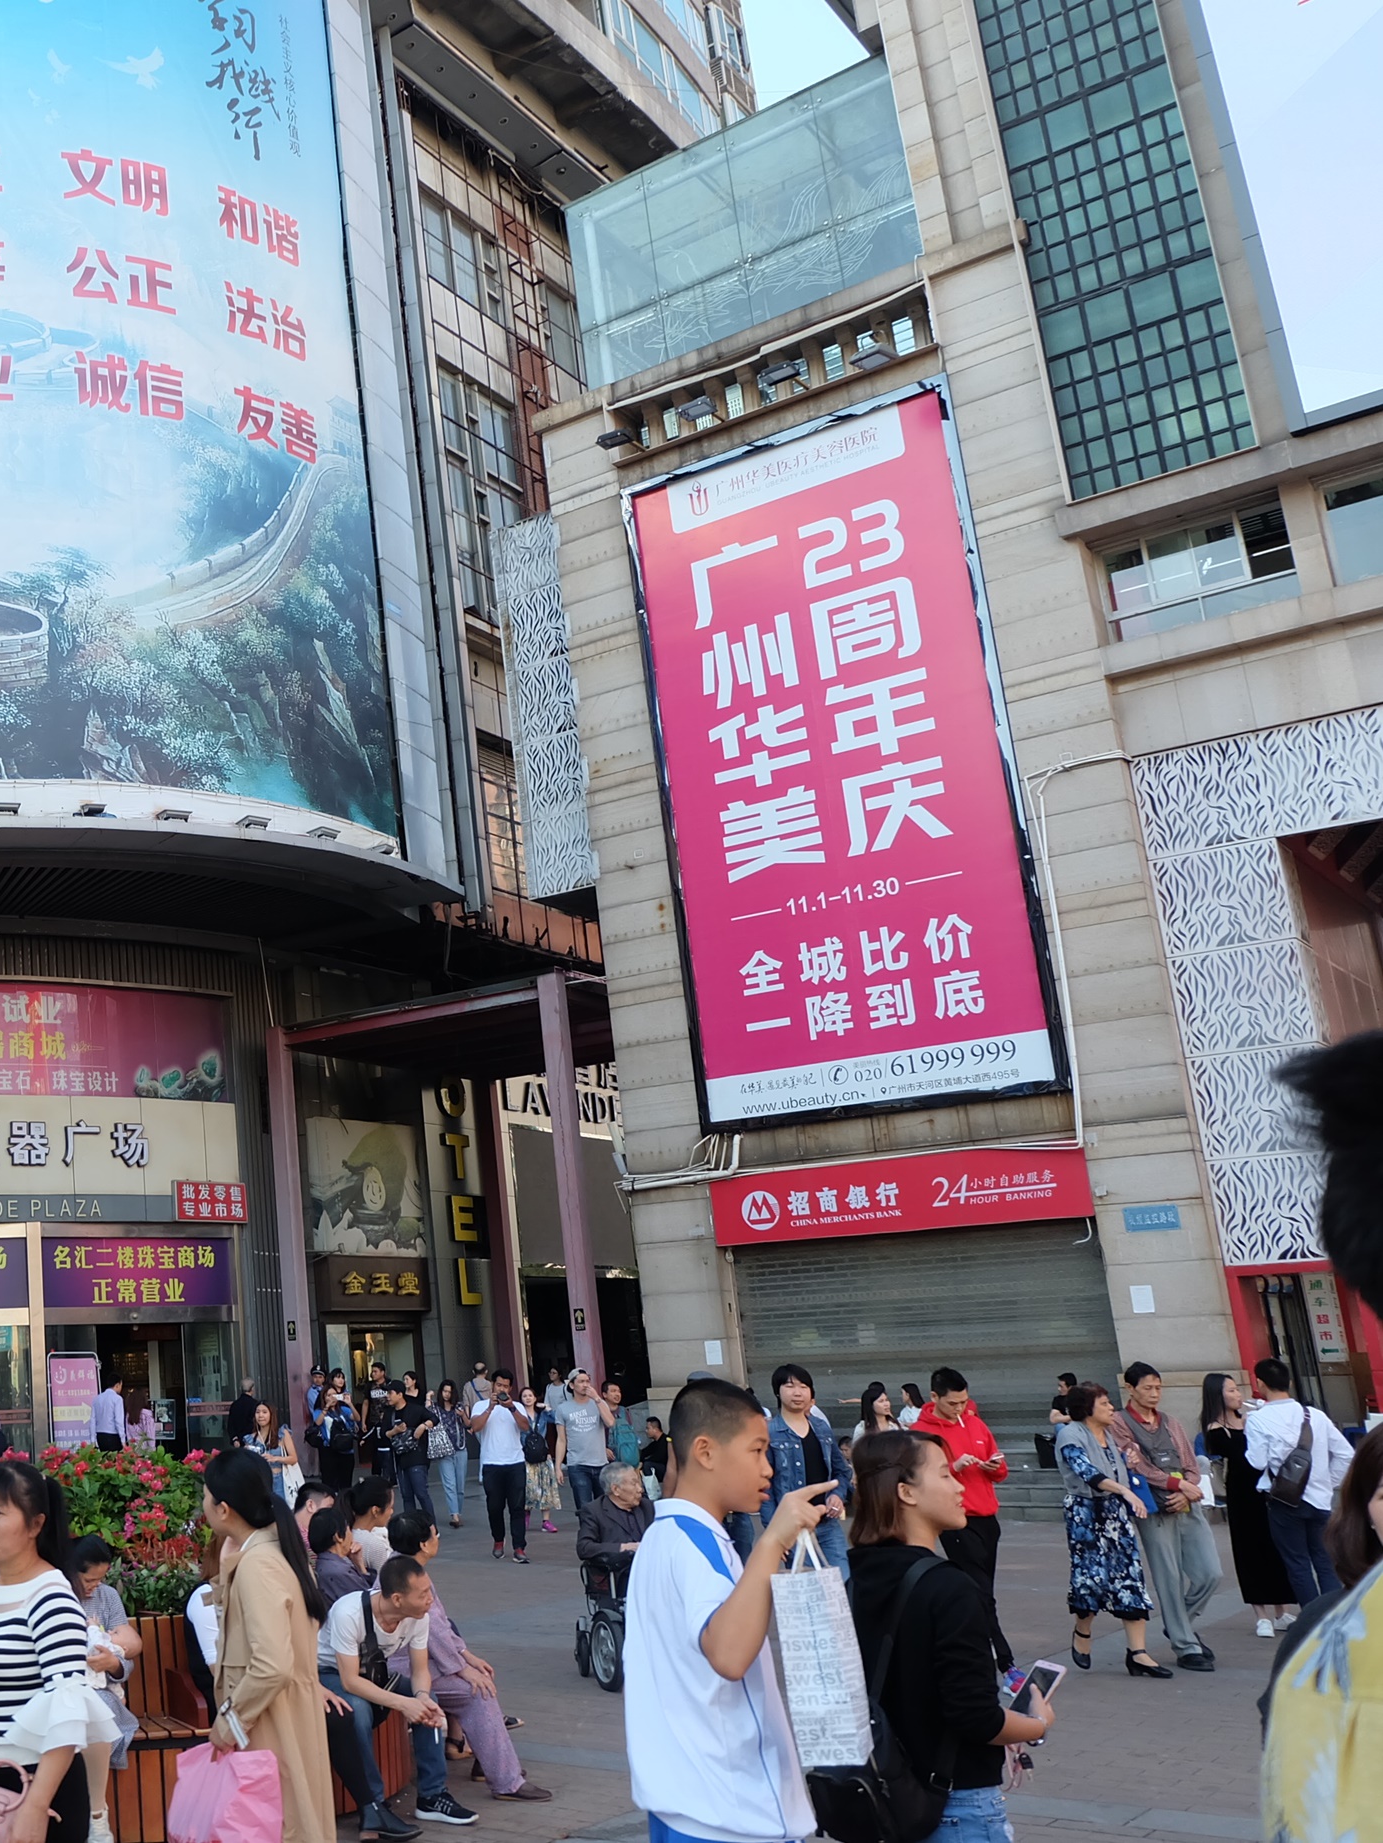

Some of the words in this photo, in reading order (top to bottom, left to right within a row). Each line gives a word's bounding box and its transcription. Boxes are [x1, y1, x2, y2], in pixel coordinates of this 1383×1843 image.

[60, 149, 170, 217] 文明
[217, 185, 301, 267] 和谐
[66, 246, 177, 316] 公正
[224, 281, 307, 362] 法治
[74, 350, 184, 421] 诚信
[234, 385, 318, 465] 友善
[715, 426, 878, 496] 广州华美医疗美容医院
[690, 535, 826, 884] 广州华美
[739, 913, 973, 996] 全城比价
[745, 969, 986, 1041] 一降到底
[742, 1090, 860, 1115] www.ubeauty.cn
[181, 1183, 243, 1202] 批发零售
[931, 1173, 969, 1208] 24
[969, 1168, 1055, 1190] 小时自助服务
[969, 1194, 999, 1205] HOUR
[1005, 1189, 1053, 1202] BANKING
[30, 1199, 102, 1218] PLAZA
[182, 1201, 244, 1219] 专业市场
[790, 1217, 819, 1228] CHINA
[819, 1211, 875, 1225] MERCHANTS
[876, 1208, 903, 1219] BANK
[53, 1244, 216, 1270] 名汇二楼珠宝商场
[91, 1278, 186, 1304] 正常营业
[340, 1270, 421, 1296] 金玉堂
